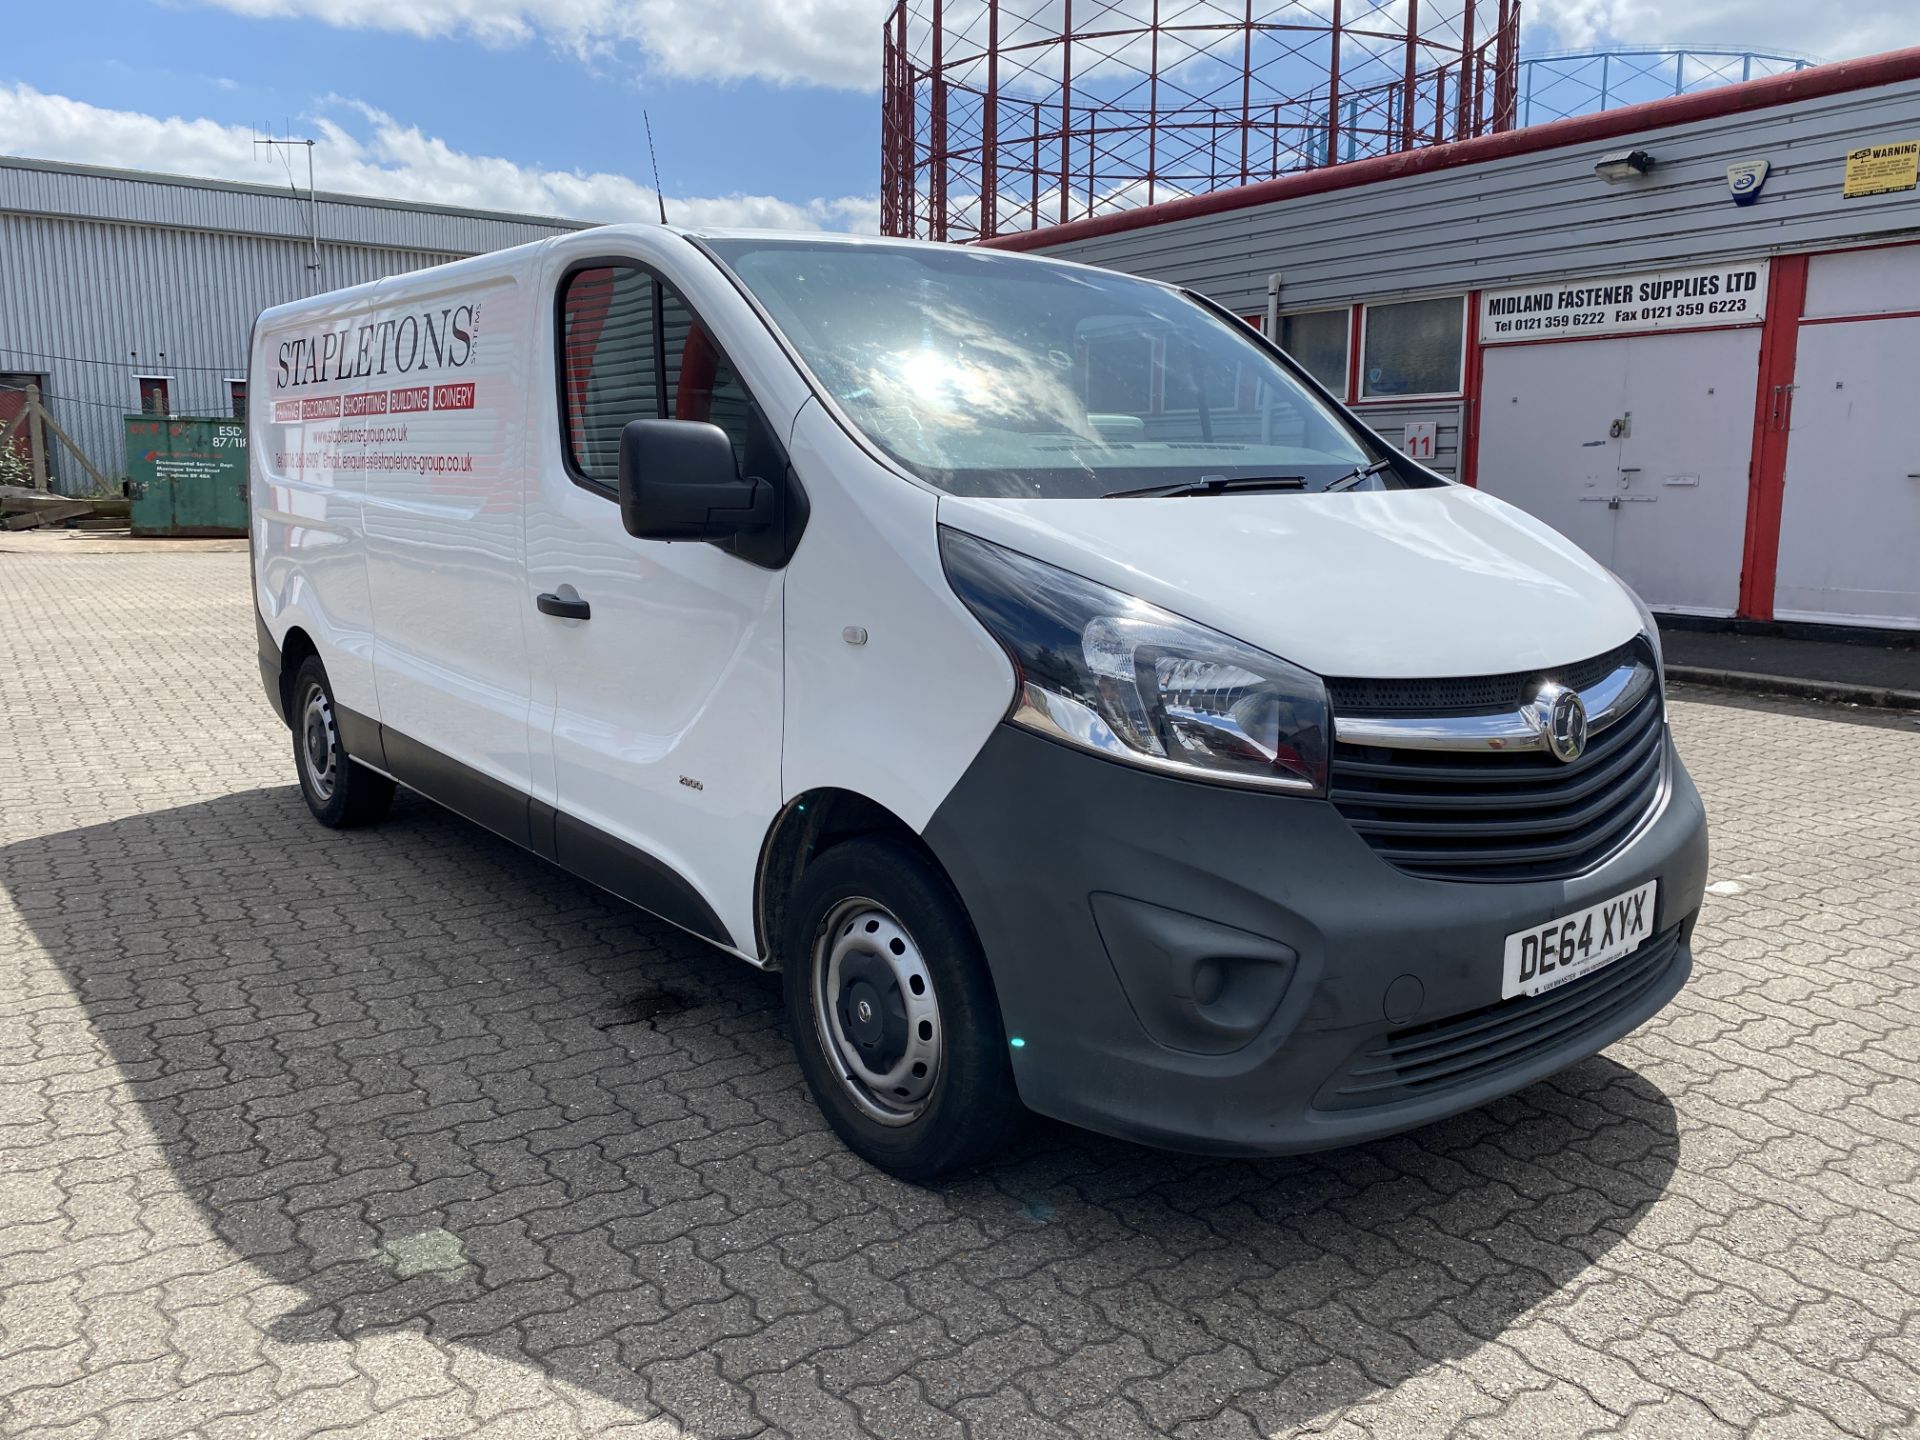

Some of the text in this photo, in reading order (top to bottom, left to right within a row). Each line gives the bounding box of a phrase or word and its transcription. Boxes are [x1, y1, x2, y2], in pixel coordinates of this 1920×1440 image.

[1873, 144, 1917, 158] WARNING
[1489, 271, 1757, 316] MIDLAND FASTENER SUPPLIES LTD
[1495, 298, 1747, 332] Tel 0121 359 6222 Fax 0121 359 6223
[276, 304, 474, 390] STAPLETONS
[470, 303, 482, 365] SYSTEMS
[303, 398, 340, 417] DECORATING
[344, 392, 386, 414] SHOPFITTING
[390, 389, 428, 411] BUILDING
[434, 386, 473, 408] JOINERY
[219, 426, 242, 436] ESD
[313, 424, 408, 447] www.stapletons-group.co.uk
[1408, 436, 1430, 456] 11
[343, 452, 473, 475] enquiries@stapletons-group.co.uk
[1519, 890, 1647, 984] DE64 XYX
